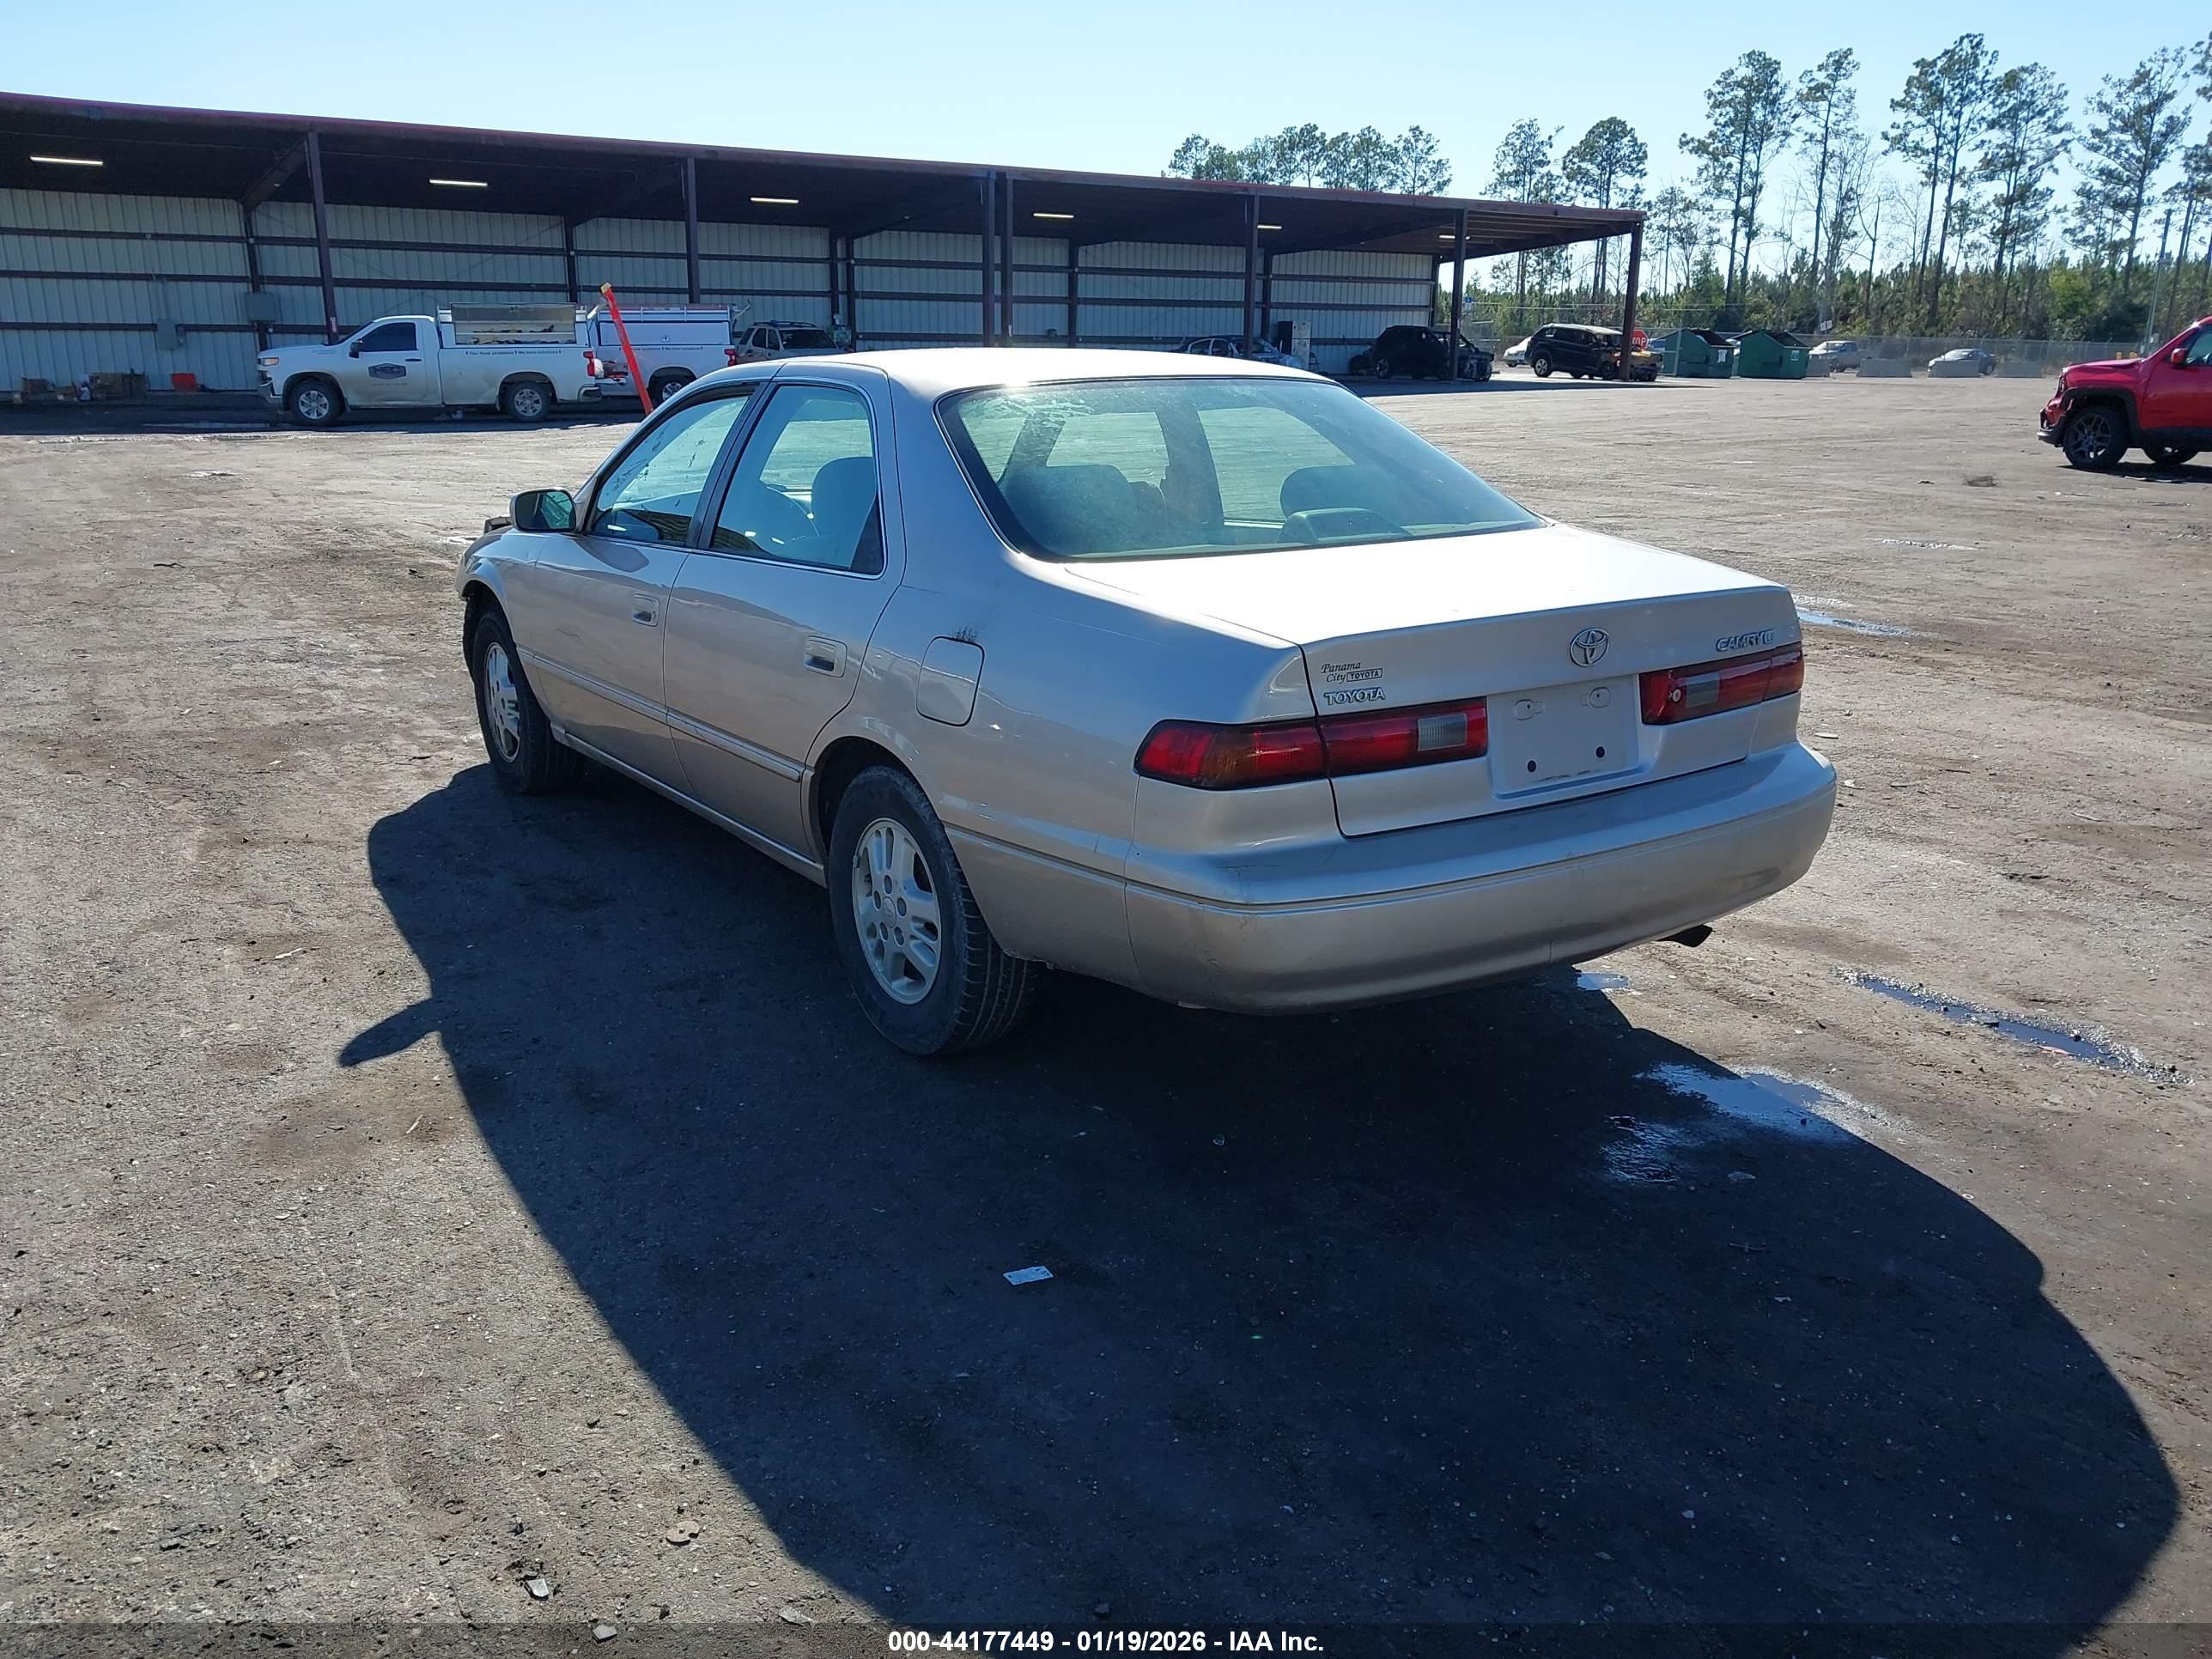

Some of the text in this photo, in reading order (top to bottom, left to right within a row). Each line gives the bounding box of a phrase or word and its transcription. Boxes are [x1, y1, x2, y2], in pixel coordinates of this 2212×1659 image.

[1632, 337, 1646, 347] TOP
[1321, 662, 1361, 674] Panama
[1326, 670, 1379, 685] City TOYOTA
[1323, 687, 1387, 706] TOYOTA
